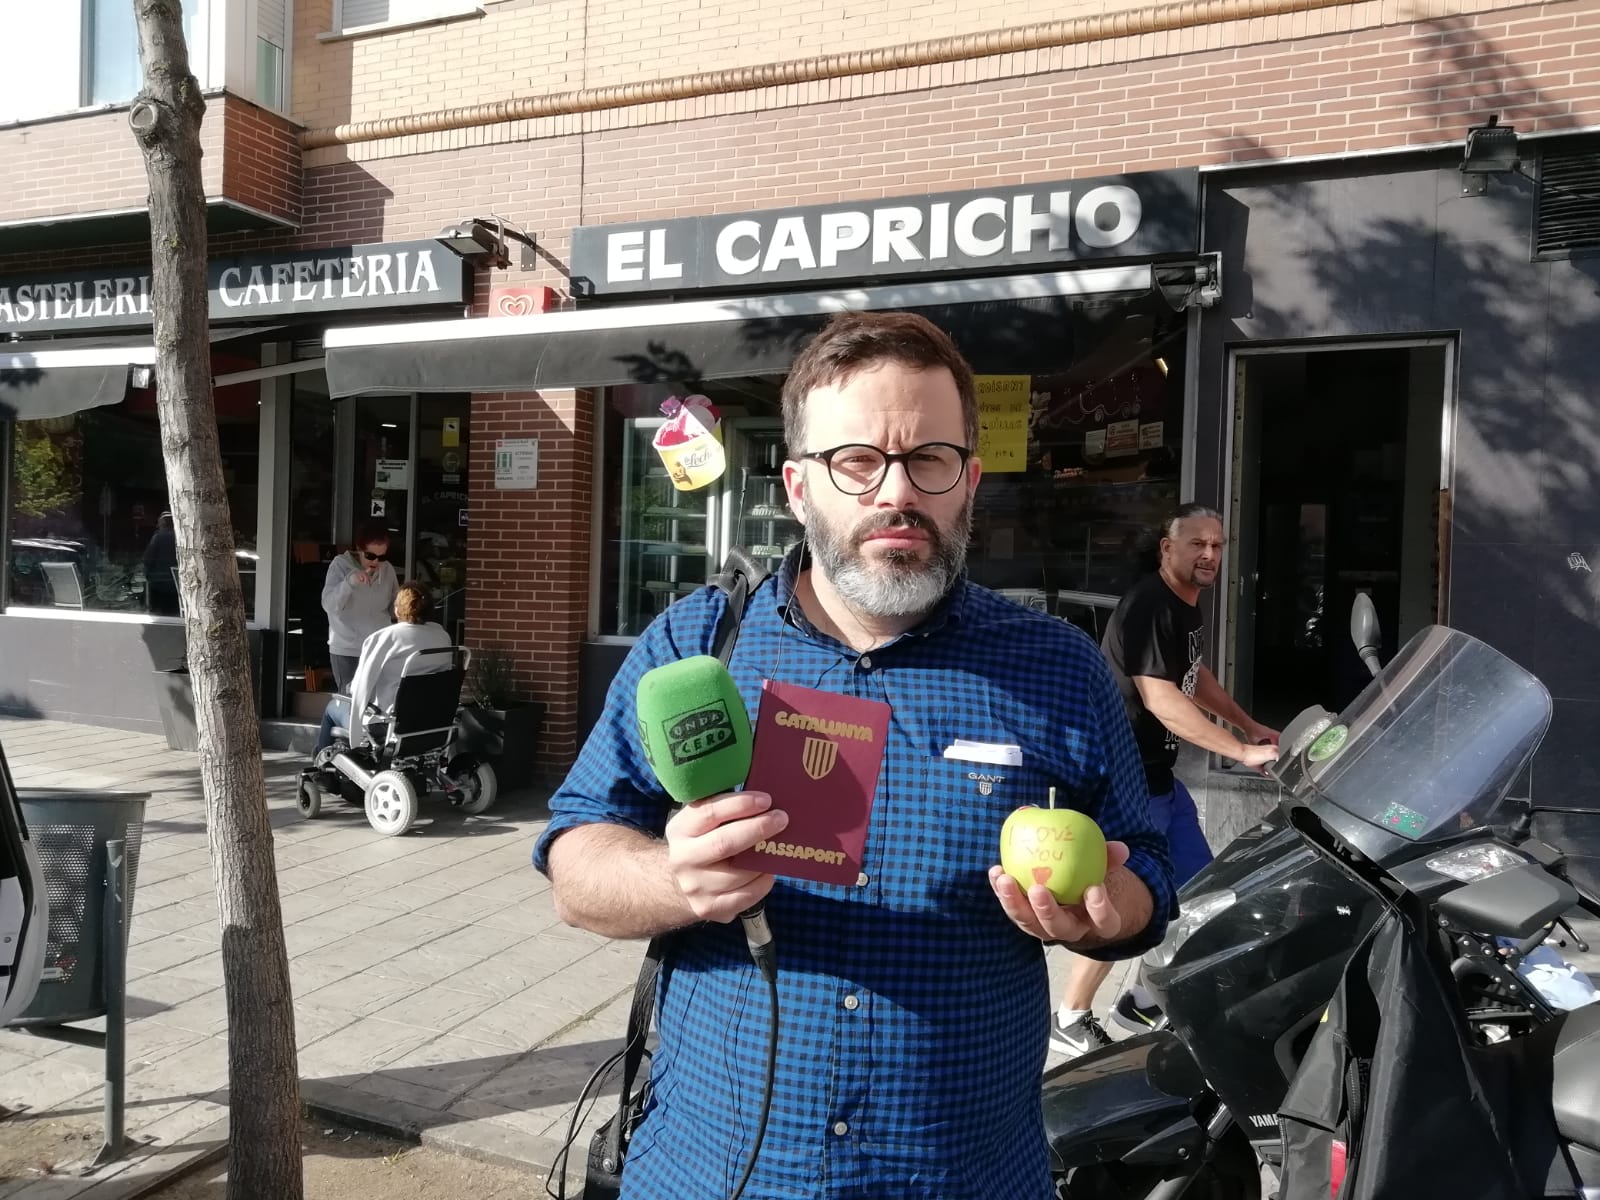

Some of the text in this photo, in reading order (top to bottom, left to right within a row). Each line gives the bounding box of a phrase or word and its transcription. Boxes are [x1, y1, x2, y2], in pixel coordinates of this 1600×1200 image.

[607, 185, 1143, 283] EL CAPRICHO
[0, 250, 441, 323] ASTELERI CAFETERIA
[674, 713, 720, 737] ONDA
[774, 711, 873, 742] CATALUNYA
[682, 729, 726, 753] CERO
[968, 772, 1006, 783] GANT
[755, 840, 846, 865] PASSAPORT
[1026, 846, 1063, 861] YOU
